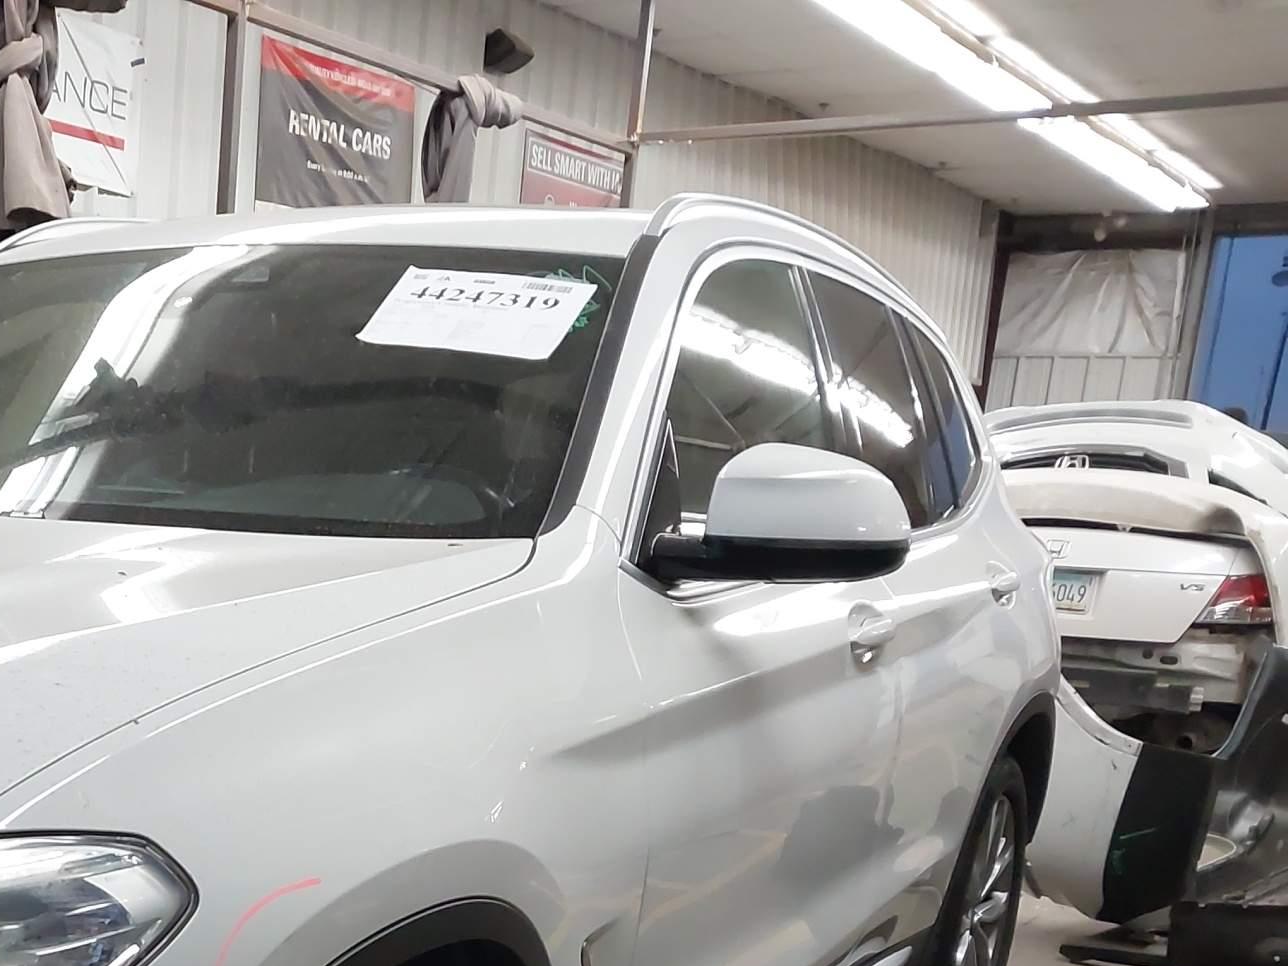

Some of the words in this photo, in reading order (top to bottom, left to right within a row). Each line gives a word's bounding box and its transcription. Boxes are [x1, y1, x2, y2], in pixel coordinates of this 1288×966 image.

[289, 109, 347, 149] RENTAL
[352, 128, 392, 160] CARS
[531, 144, 552, 171] SELL
[554, 151, 587, 182] SMART
[587, 161, 611, 190] WITH
[410, 286, 560, 310] 44247319
